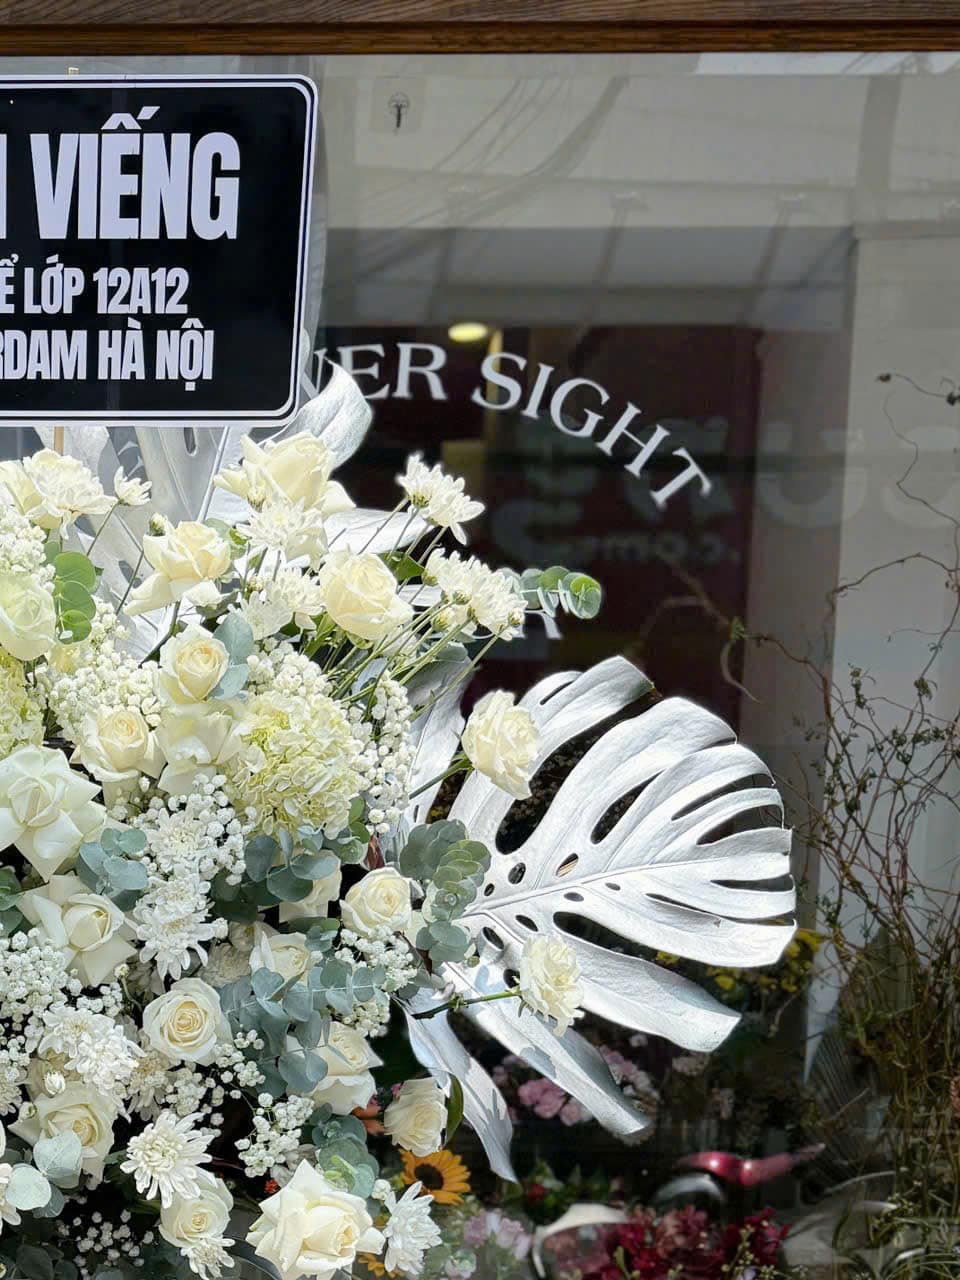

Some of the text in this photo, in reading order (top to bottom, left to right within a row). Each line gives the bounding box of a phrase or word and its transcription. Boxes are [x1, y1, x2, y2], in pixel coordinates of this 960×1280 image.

[29, 105, 242, 240] VIẾNG
[23, 253, 86, 314] LỚP
[92, 266, 190, 314] 12A12
[97, 316, 146, 380] HÀ
[155, 317, 215, 391] NỘI
[471, 352, 712, 511] SIGHT
